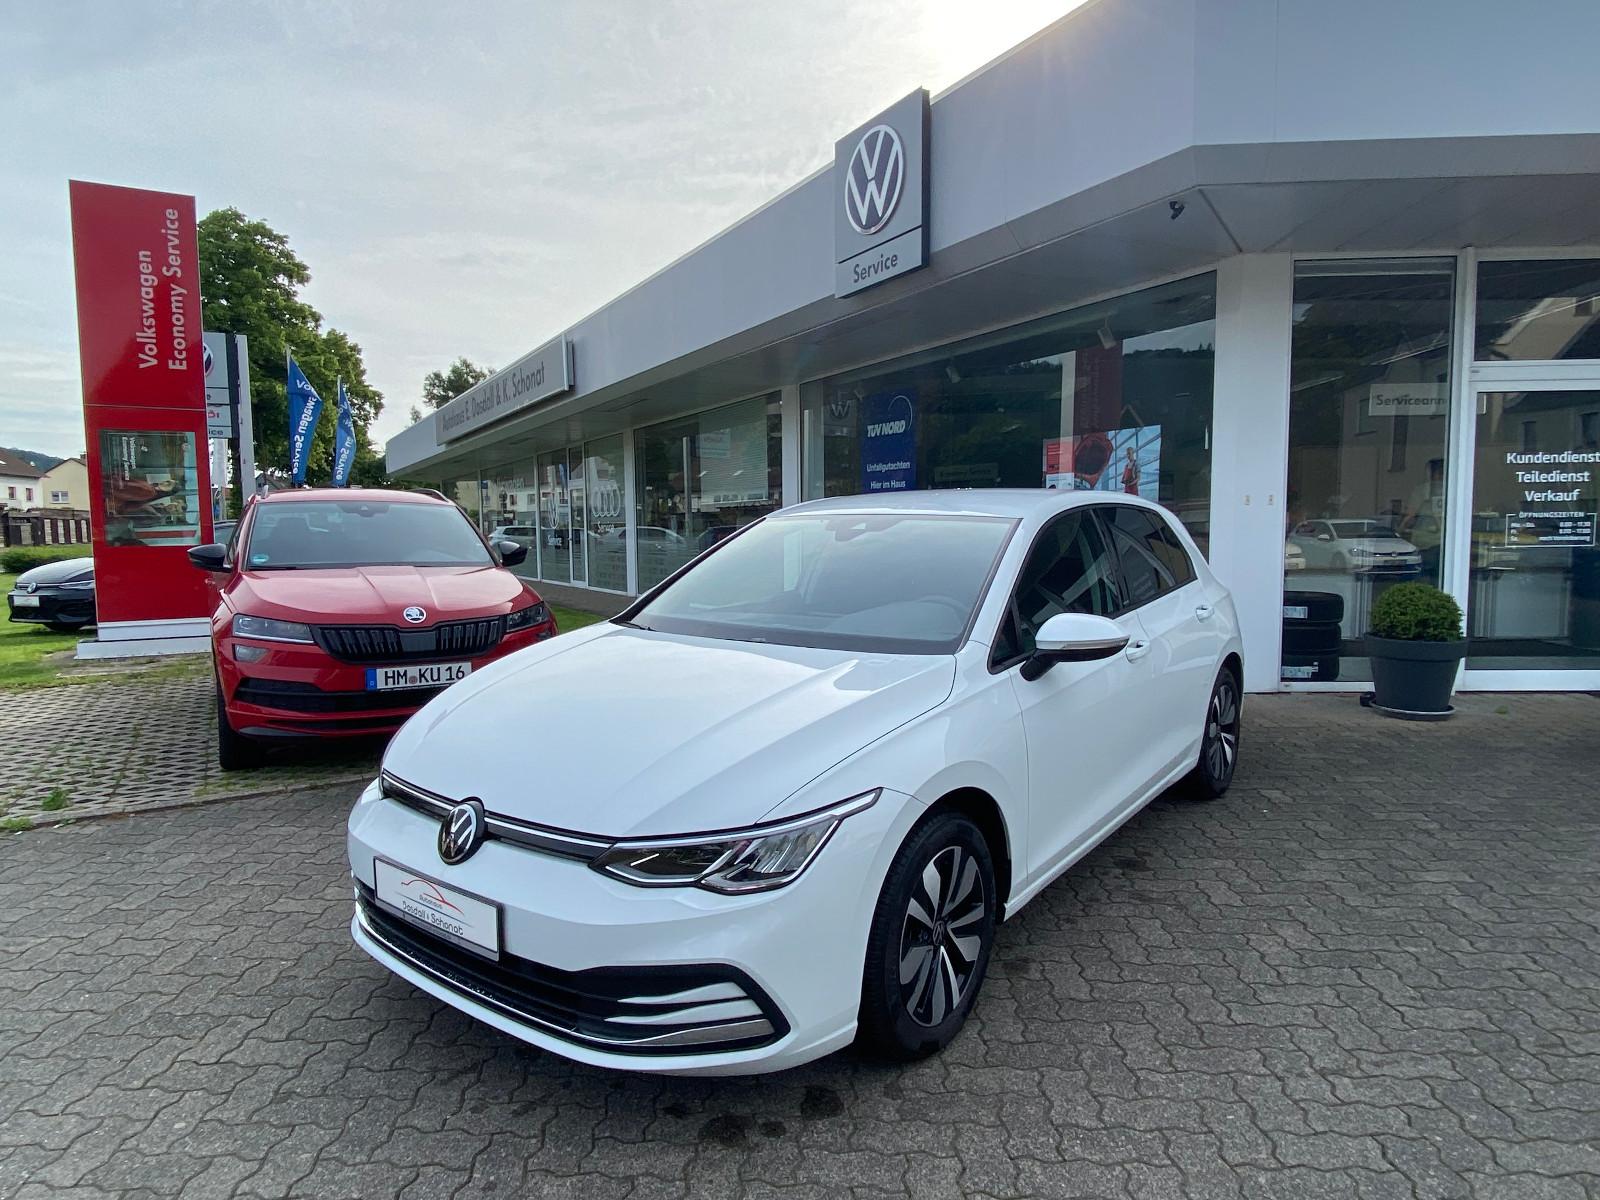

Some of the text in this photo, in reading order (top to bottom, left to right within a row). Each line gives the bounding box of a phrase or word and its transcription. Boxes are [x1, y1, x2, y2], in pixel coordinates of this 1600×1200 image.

[853, 253, 898, 283] Service
[162, 208, 187, 370] Economy Service
[136, 250, 158, 369] Volkswagen
[512, 360, 545, 398] Schonat
[882, 420, 906, 436] NORD
[1506, 450, 1600, 464] Kundendienst
[870, 481, 882, 490] Hier
[891, 479, 906, 488] Haus
[1516, 470, 1591, 483] Teiledienst
[1525, 489, 1581, 502] Verkauf
[384, 665, 465, 686] HM KU 16
